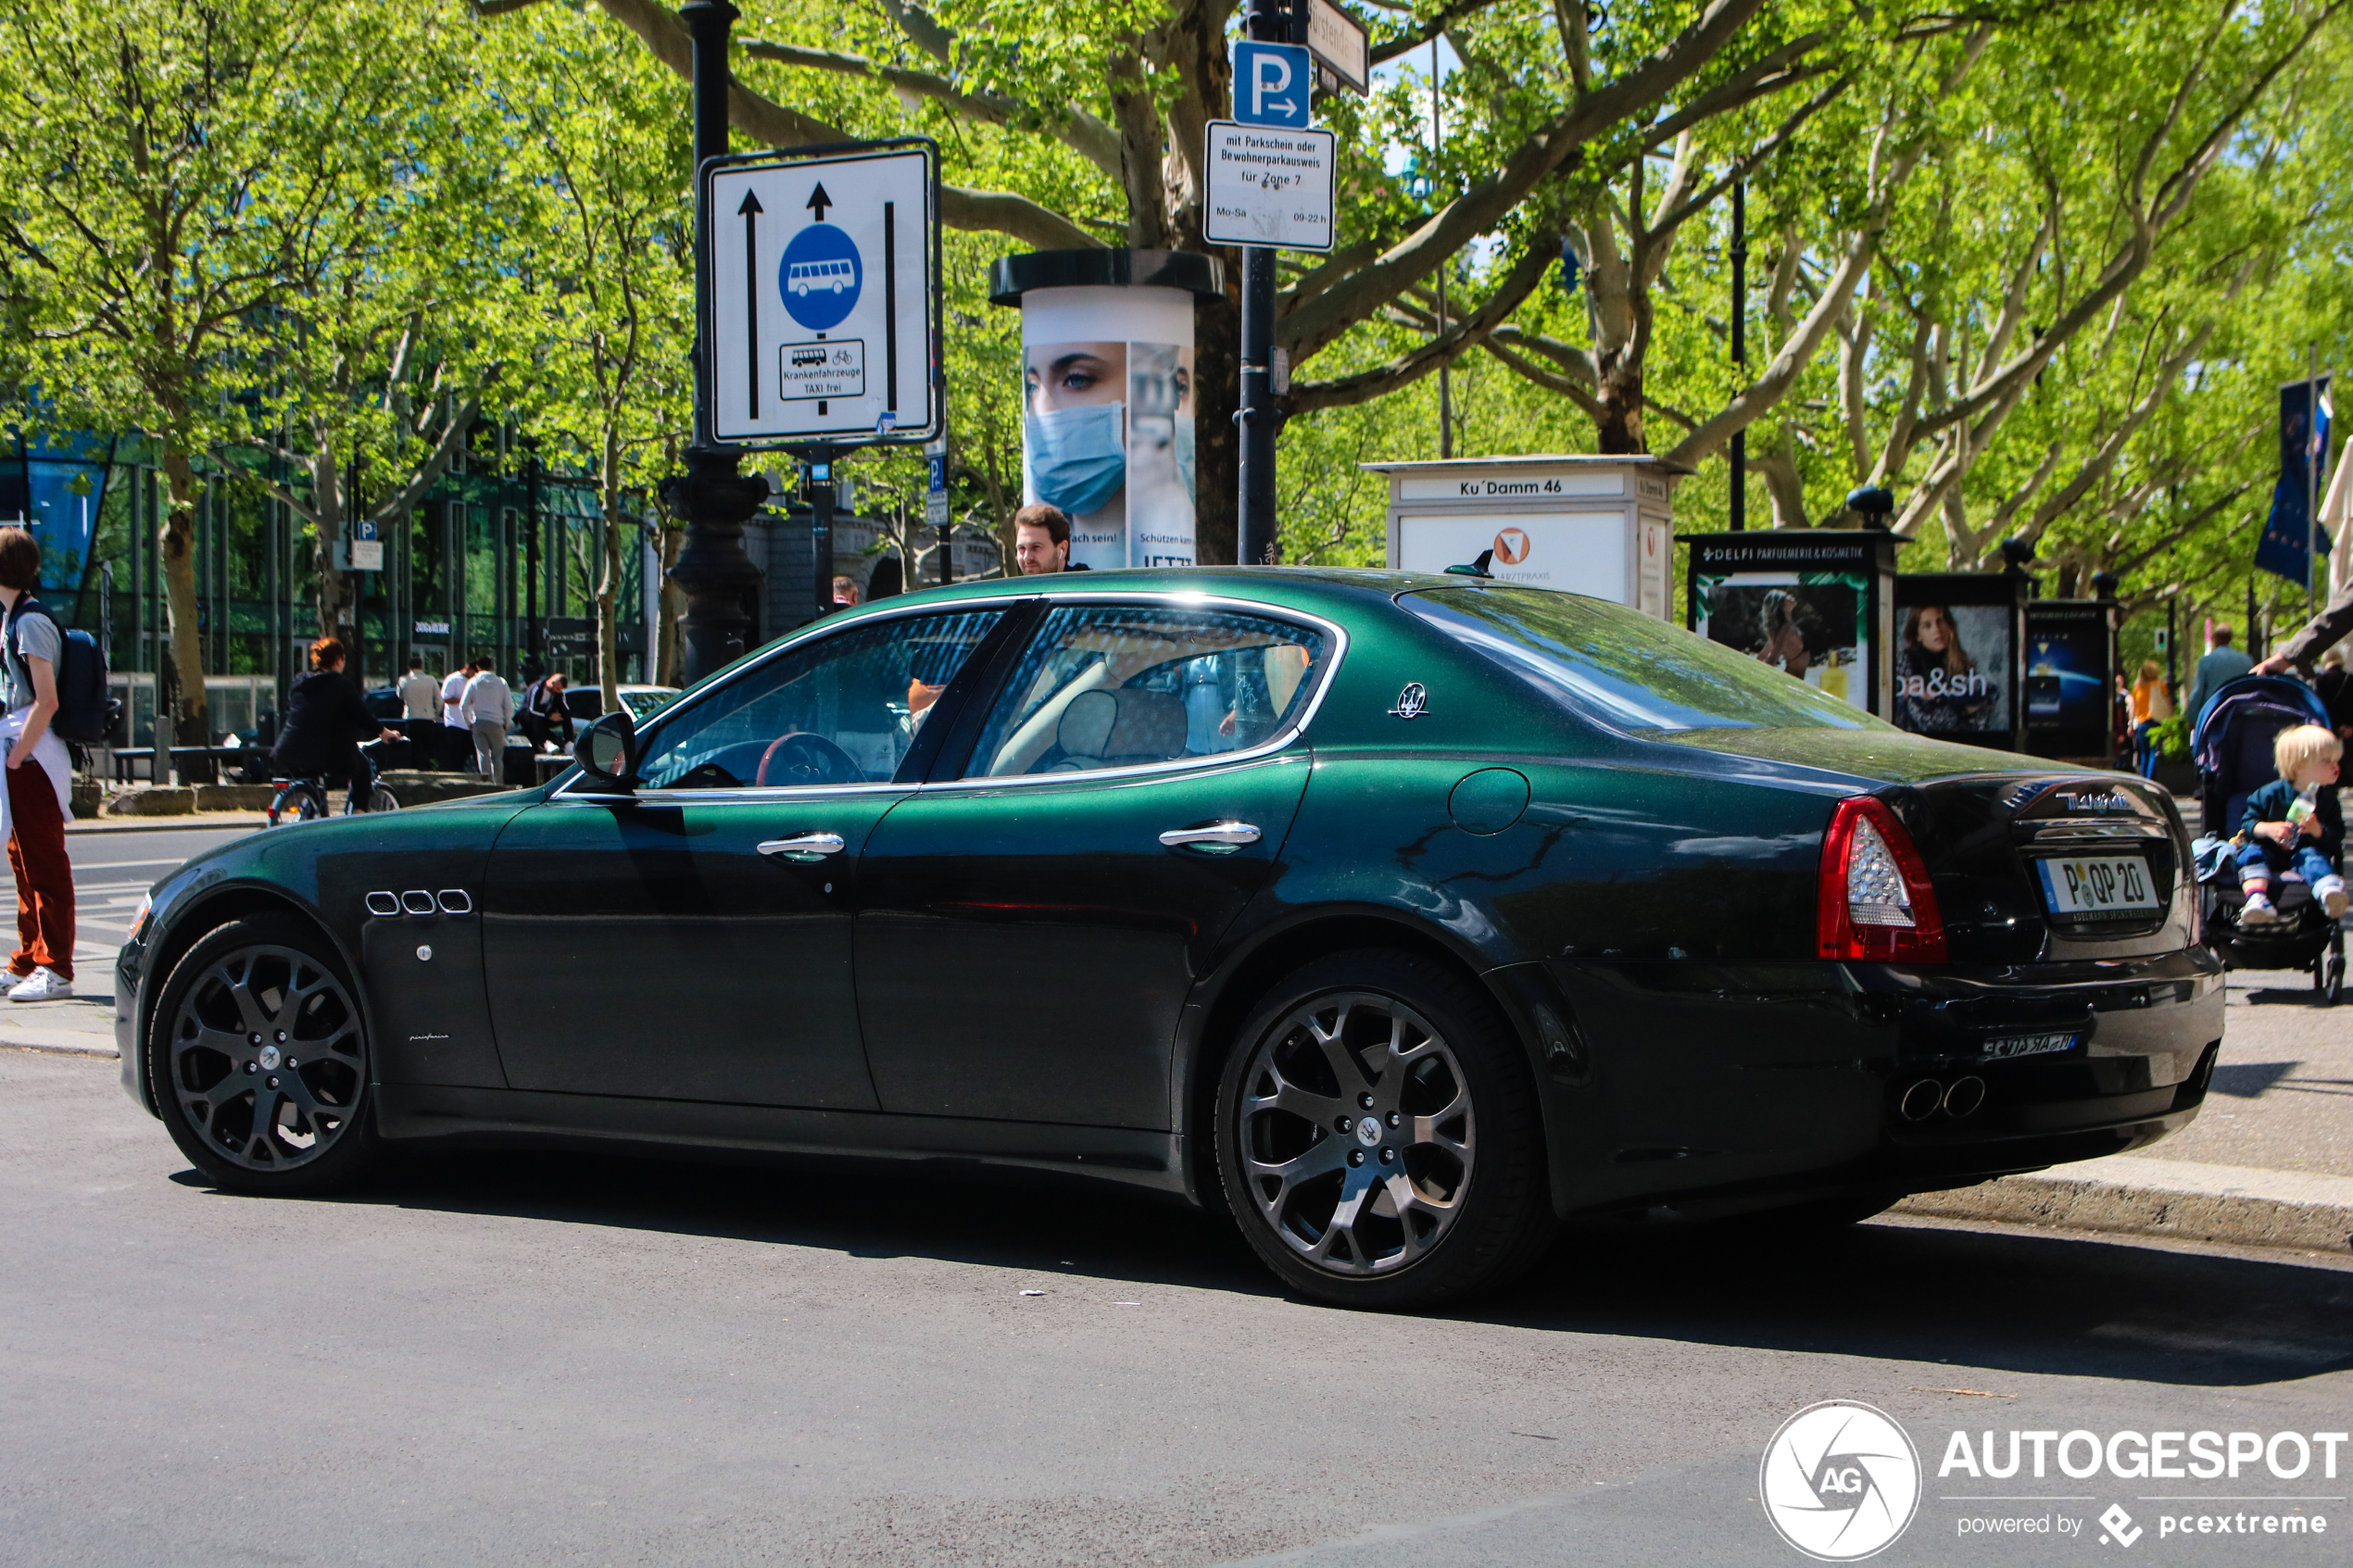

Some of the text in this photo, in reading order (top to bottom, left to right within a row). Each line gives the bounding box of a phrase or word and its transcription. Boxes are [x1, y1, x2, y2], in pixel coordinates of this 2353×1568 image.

[1252, 52, 1291, 116] P
[1227, 135, 1316, 153] mit Parkschein oder
[1241, 170, 1301, 186] für Zone 7
[1216, 207, 1247, 218] Mo-Sa
[1320, 215, 1327, 224] h
[784, 368, 861, 381] Krankenfahrzeuge
[804, 382, 842, 395] TAXI frei
[1543, 479, 1562, 494] 46
[361, 523, 373, 539] P
[1092, 533, 1117, 543] sein!
[1140, 533, 1178, 544] Schützen
[1715, 547, 1754, 560] DELFI
[2063, 862, 2145, 905] P QP 20
